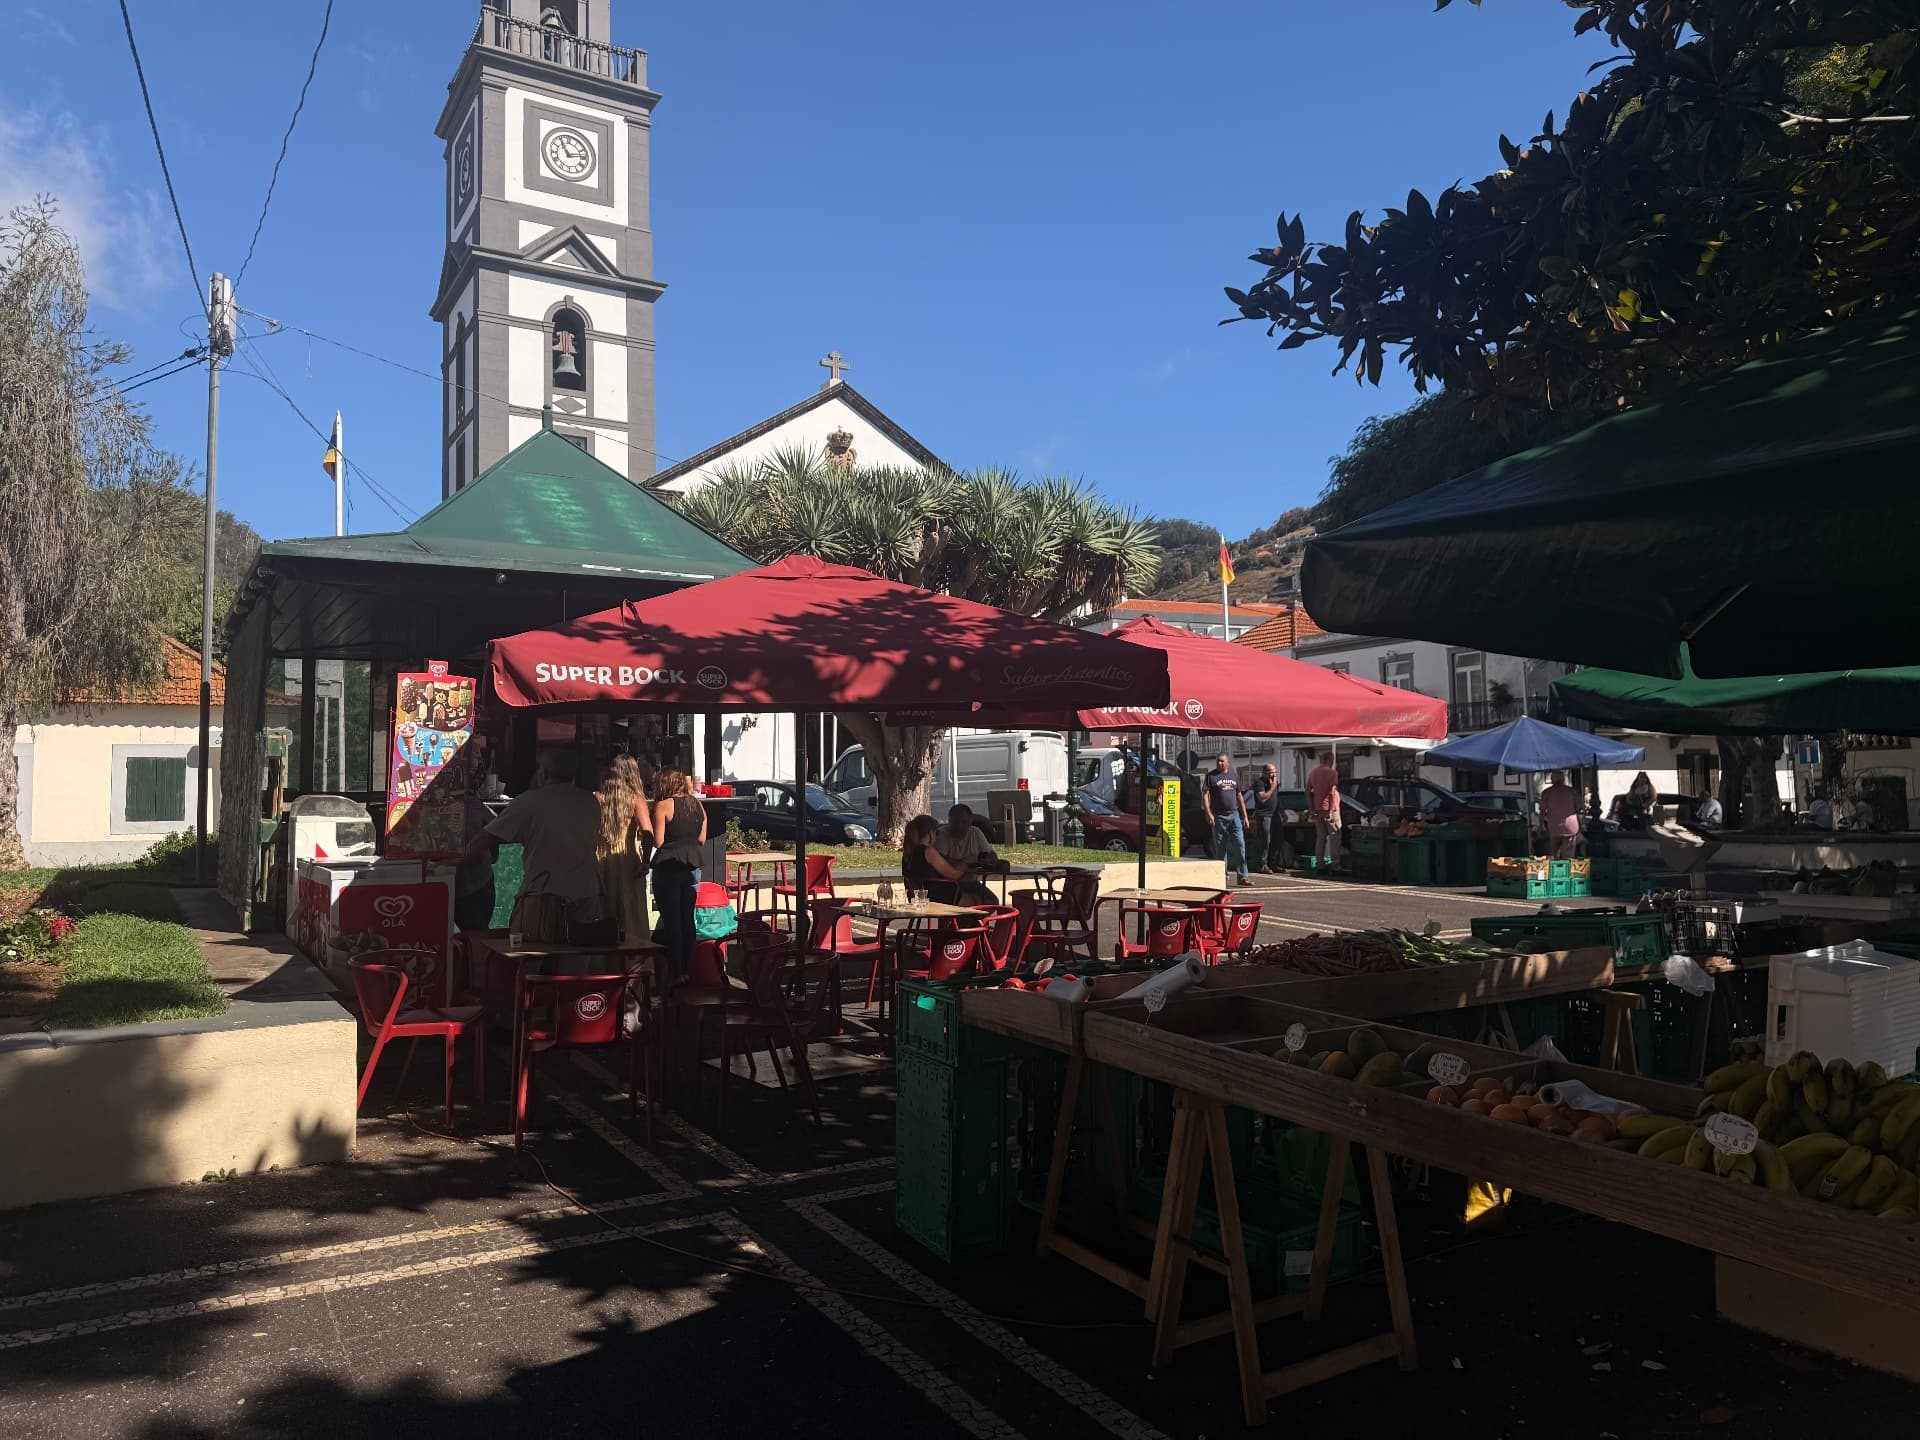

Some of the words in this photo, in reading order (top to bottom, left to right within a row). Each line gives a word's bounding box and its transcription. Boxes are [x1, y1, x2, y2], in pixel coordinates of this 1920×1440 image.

[535, 663, 614, 686] SUPER
[618, 665, 688, 686] BOCK
[1000, 664, 1050, 686] Sabor
[381, 916, 408, 929] OLÁ
